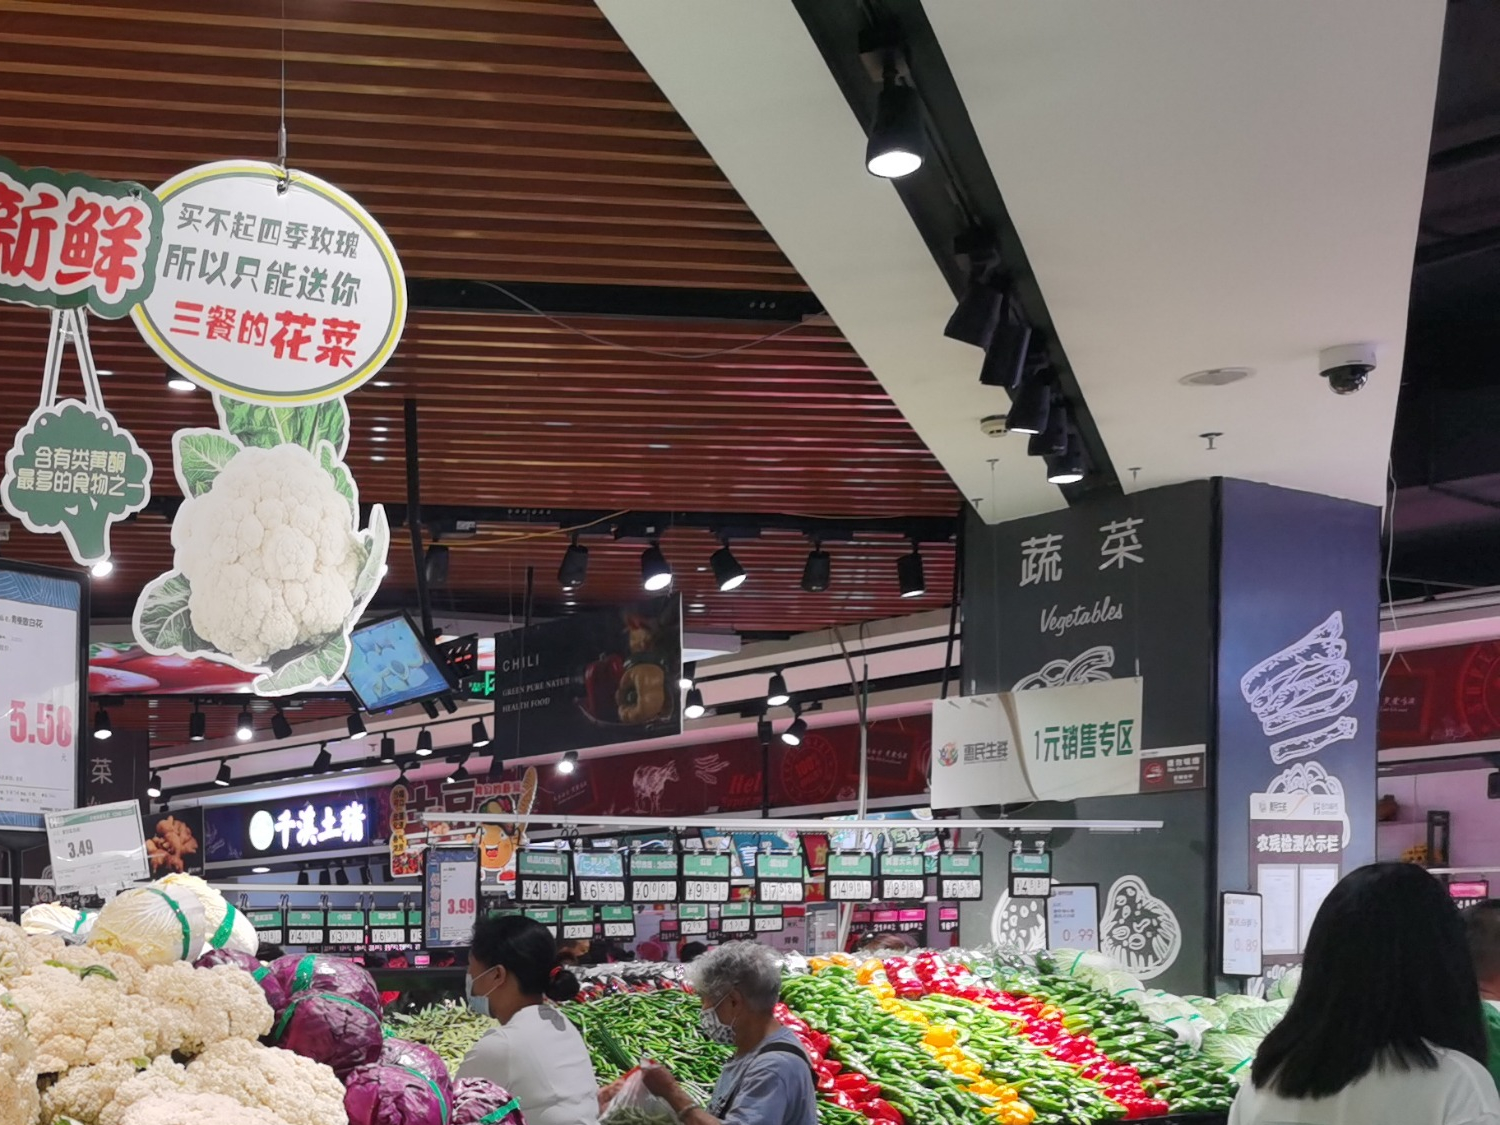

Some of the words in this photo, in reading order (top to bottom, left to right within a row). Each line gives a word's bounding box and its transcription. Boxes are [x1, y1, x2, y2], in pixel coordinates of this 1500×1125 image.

[177, 203, 360, 259] 买不起四季玫瑰
[162, 244, 361, 307] 所以只能送你
[170, 301, 361, 368] 三餐的花菜
[34, 446, 127, 474] 含有类黄酮
[16, 468, 144, 497] 最多的食物之一
[1040, 596, 1123, 637] Vegetables
[502, 653, 540, 672] CHILI
[526, 682, 544, 692] PURE
[502, 702, 529, 713] HEALTH
[531, 697, 551, 707] FOOD
[9, 700, 73, 748] 5.58
[1033, 719, 1135, 762] 1元销售专区
[90, 757, 113, 784] 菜
[67, 839, 94, 858] 3.49
[448, 898, 474, 914] 3.99
[1062, 928, 1094, 941] 0.99
